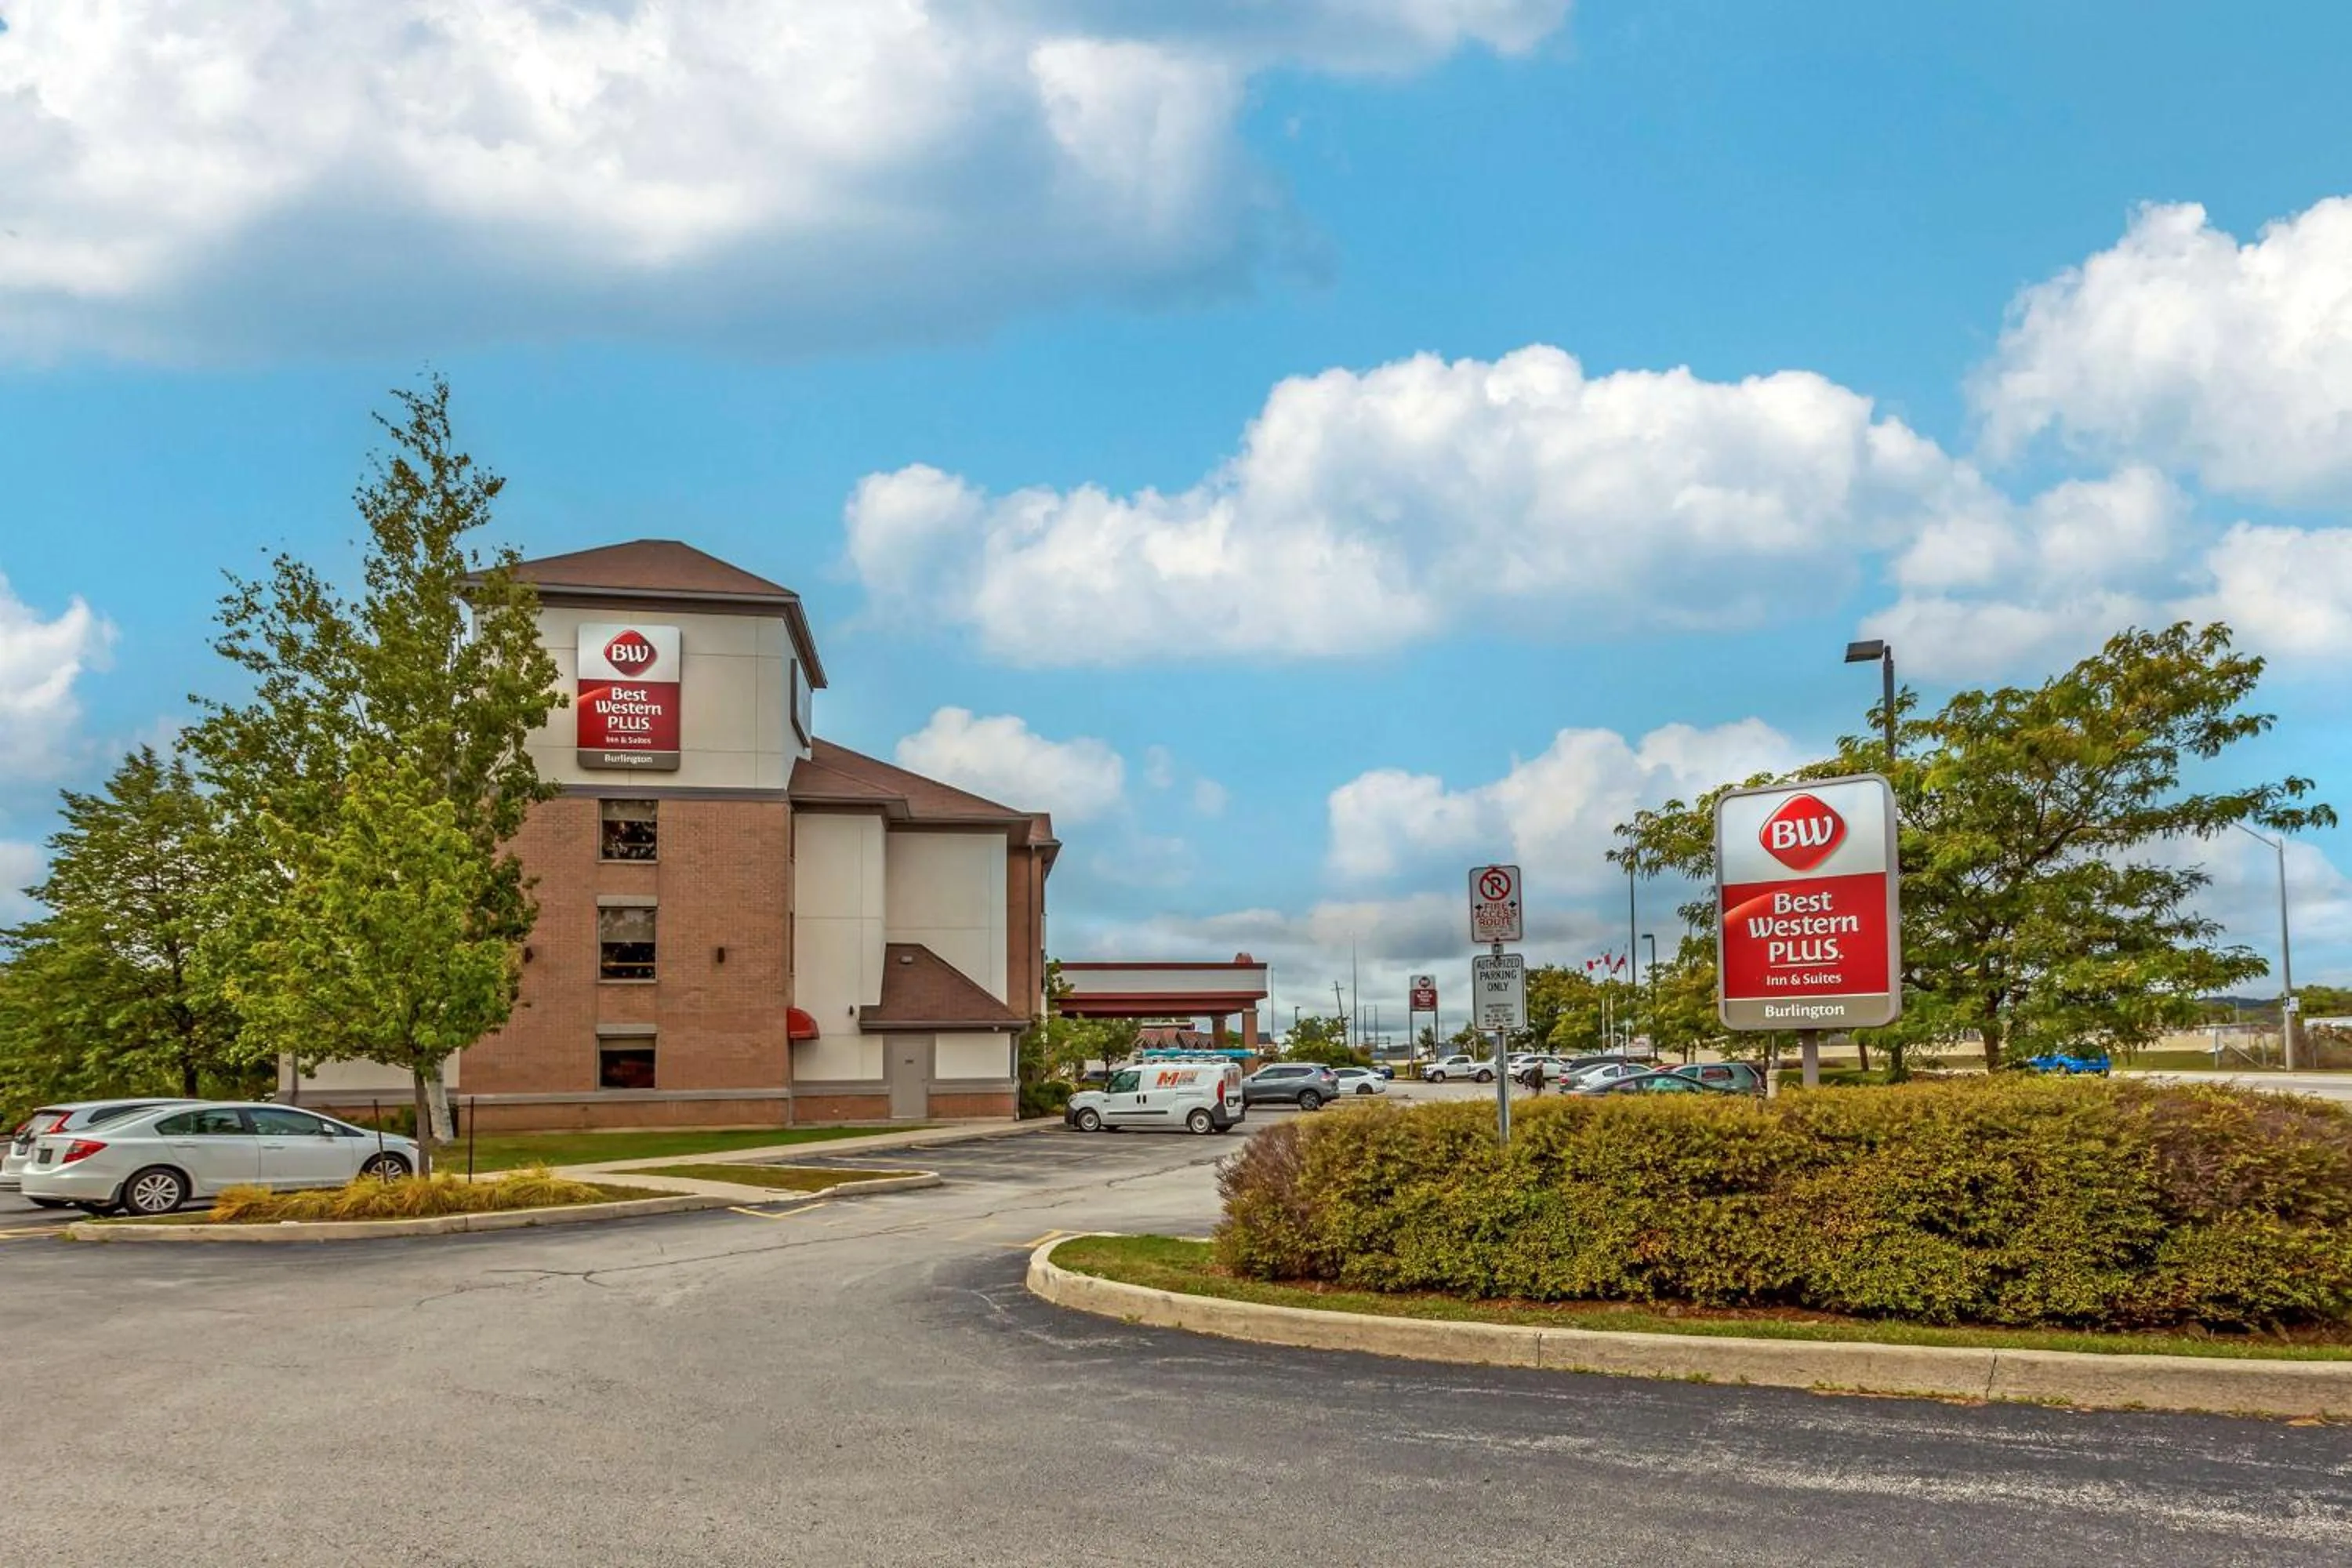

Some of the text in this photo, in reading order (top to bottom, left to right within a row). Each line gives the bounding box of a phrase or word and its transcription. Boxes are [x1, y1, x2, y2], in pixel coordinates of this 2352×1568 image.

[612, 644, 648, 662] BW
[612, 687, 648, 701] Best
[596, 700, 662, 715] Western
[604, 753, 653, 764] Burlington
[1772, 815, 1834, 849] BW
[1774, 891, 1833, 914] Best
[1475, 909, 1517, 919] ACCESS
[1479, 917, 1512, 926] ROUTE
[1748, 915, 1859, 938] Western
[1477, 958, 1520, 969] AUTHORIZED
[1479, 969, 1517, 981] PARKING
[1766, 972, 1842, 985] Inn & Suites
[1486, 982, 1509, 992] ONLY
[1765, 1004, 1845, 1019] Burlington
